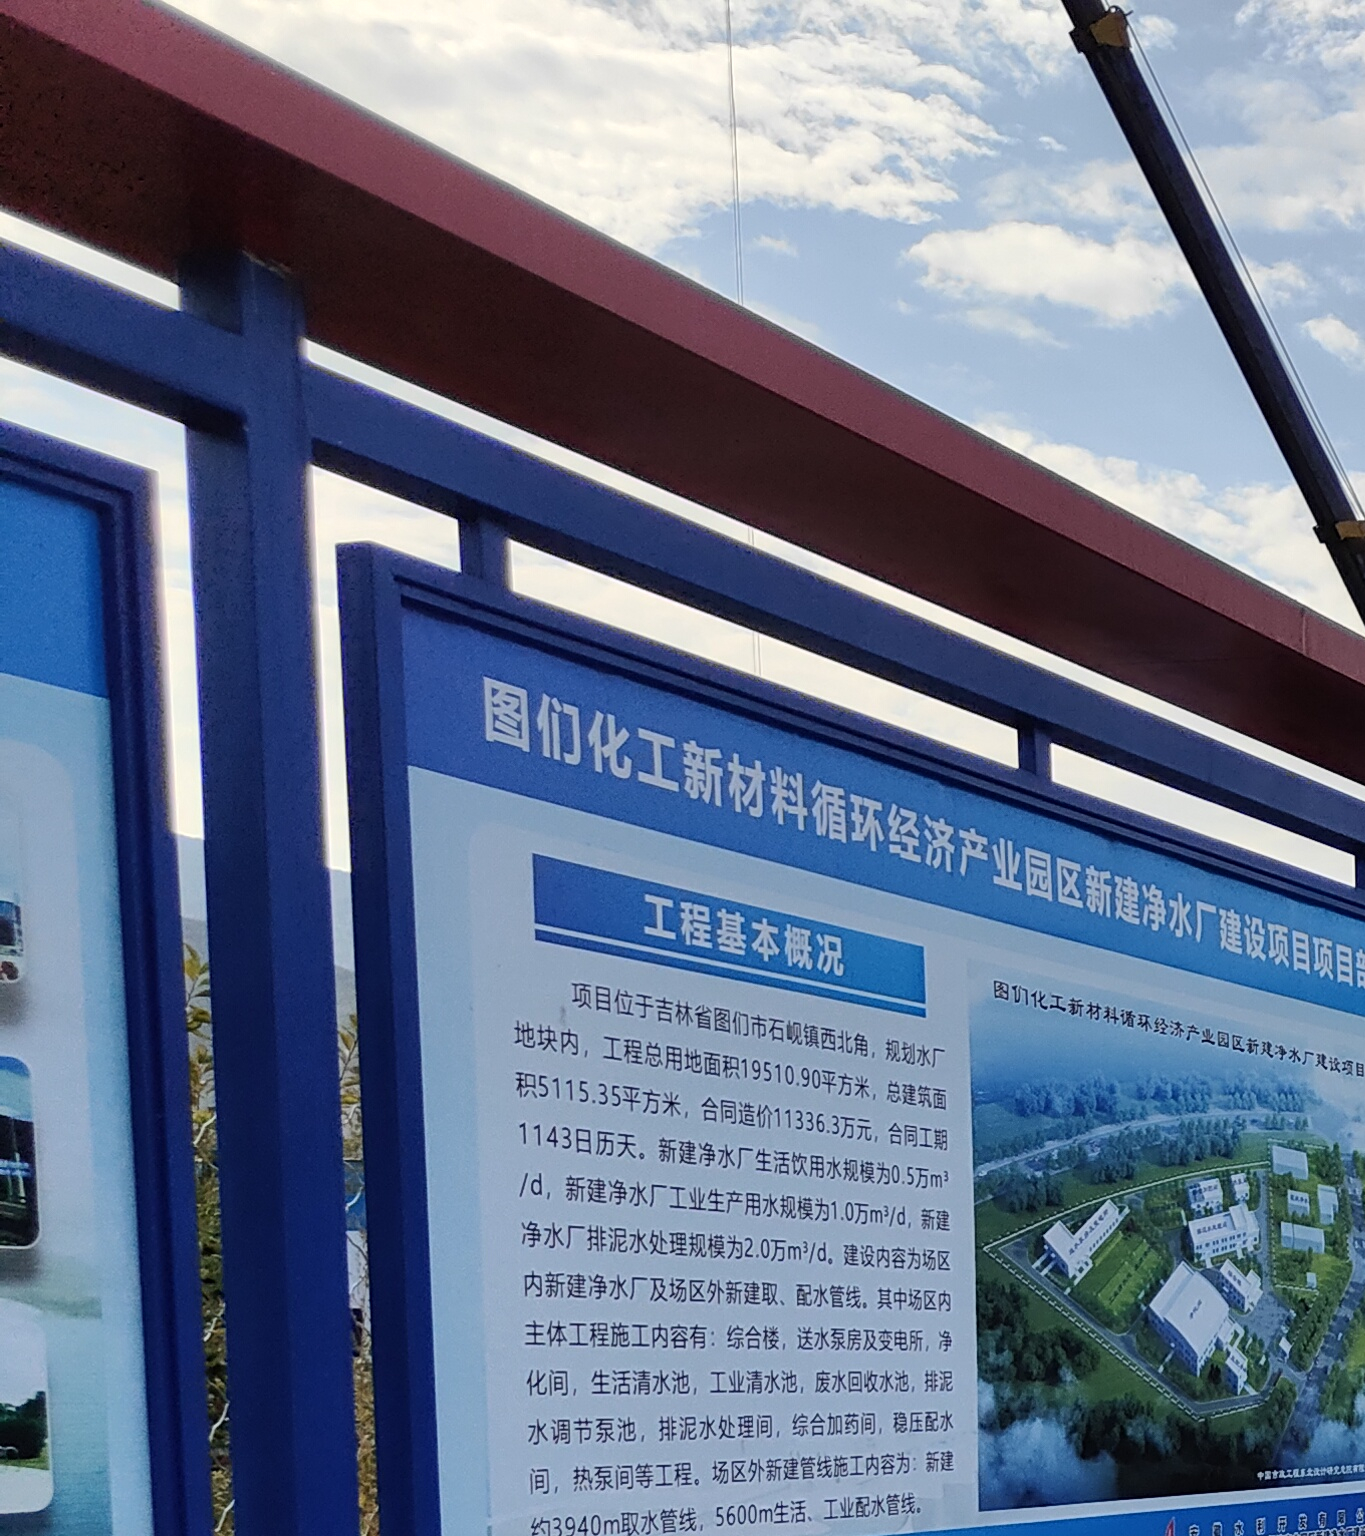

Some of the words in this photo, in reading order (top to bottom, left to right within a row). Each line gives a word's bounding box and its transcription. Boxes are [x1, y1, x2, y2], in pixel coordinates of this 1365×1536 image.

[643, 893, 845, 978] 工程基本概况
[992, 979, 1365, 1078] 图们化工新材料循环经济产业园区新建净水厂建设项目
